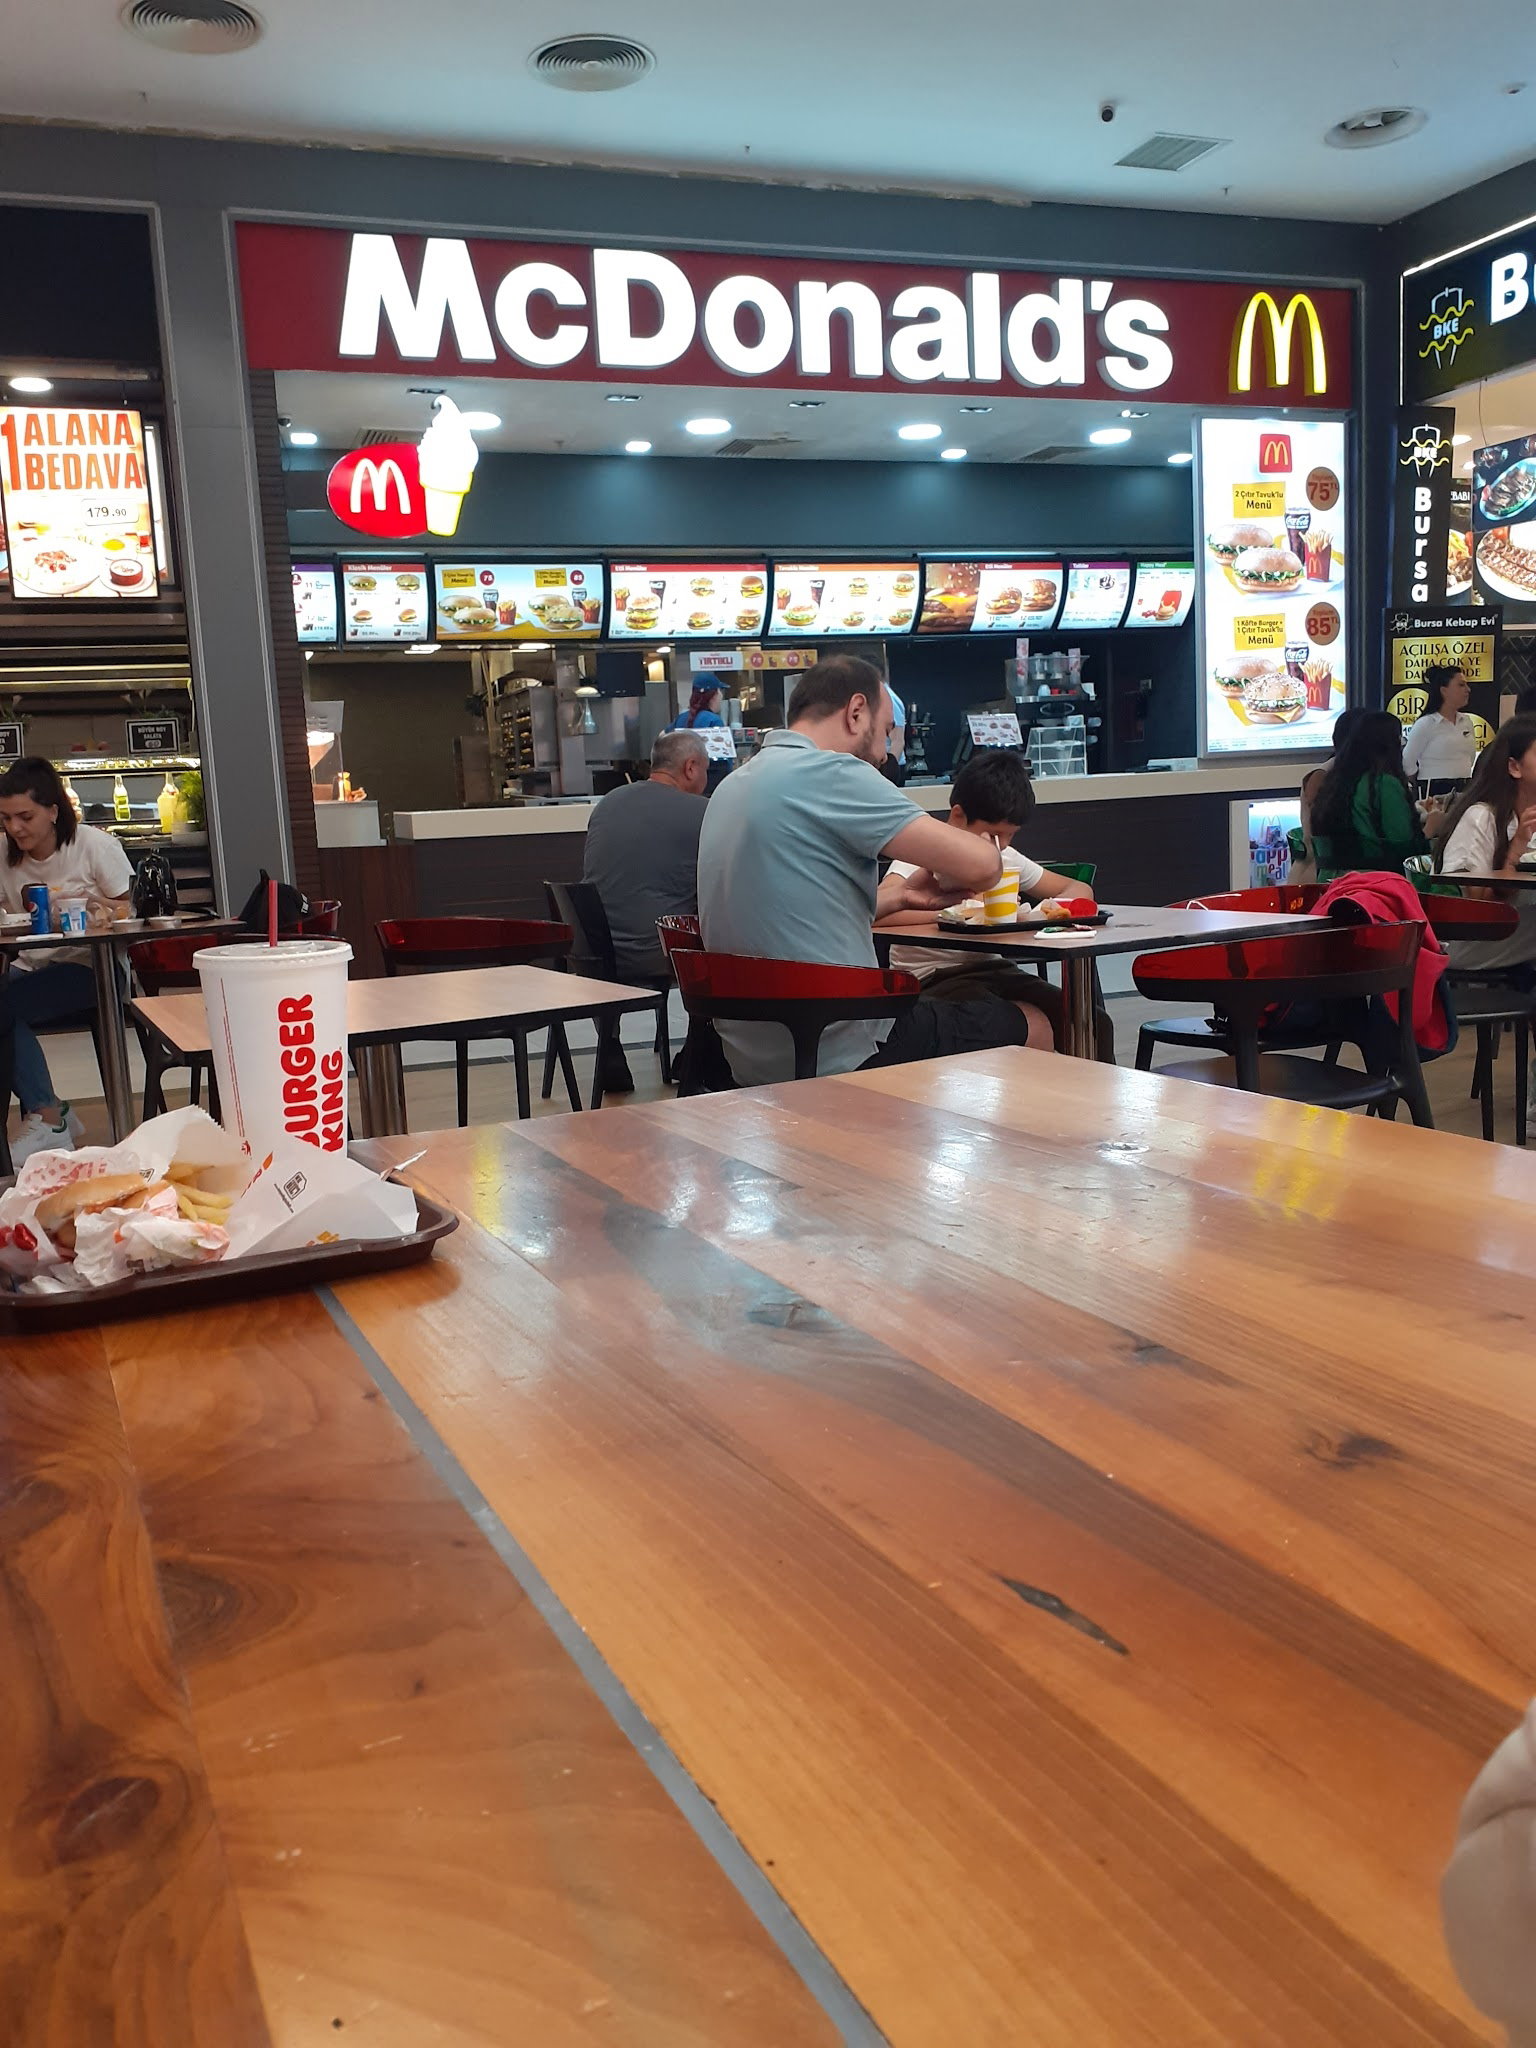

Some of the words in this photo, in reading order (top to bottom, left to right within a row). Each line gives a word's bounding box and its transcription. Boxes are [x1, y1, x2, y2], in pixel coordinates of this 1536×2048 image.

[1490, 251, 1536, 326] B
[337, 232, 1175, 393] McDonald's
[1433, 317, 1459, 340] BKE
[1, 414, 21, 490] 1
[24, 413, 135, 446] ALANA
[25, 453, 143, 490] BEDAVA
[86, 506, 127, 518] 179.90
[1246, 500, 1272, 509] Menü
[1414, 619, 1443, 628] Bursa
[1446, 617, 1478, 629] Kebap
[1248, 635, 1274, 644] Menü
[1399, 643, 1449, 658] AÇILIŞA
[1452, 640, 1488, 655] ÖZEL
[1405, 659, 1435, 668] DAHA
[1468, 656, 1481, 666] YE
[1396, 694, 1425, 715] BİR
[320, 1049, 343, 1153] KING
